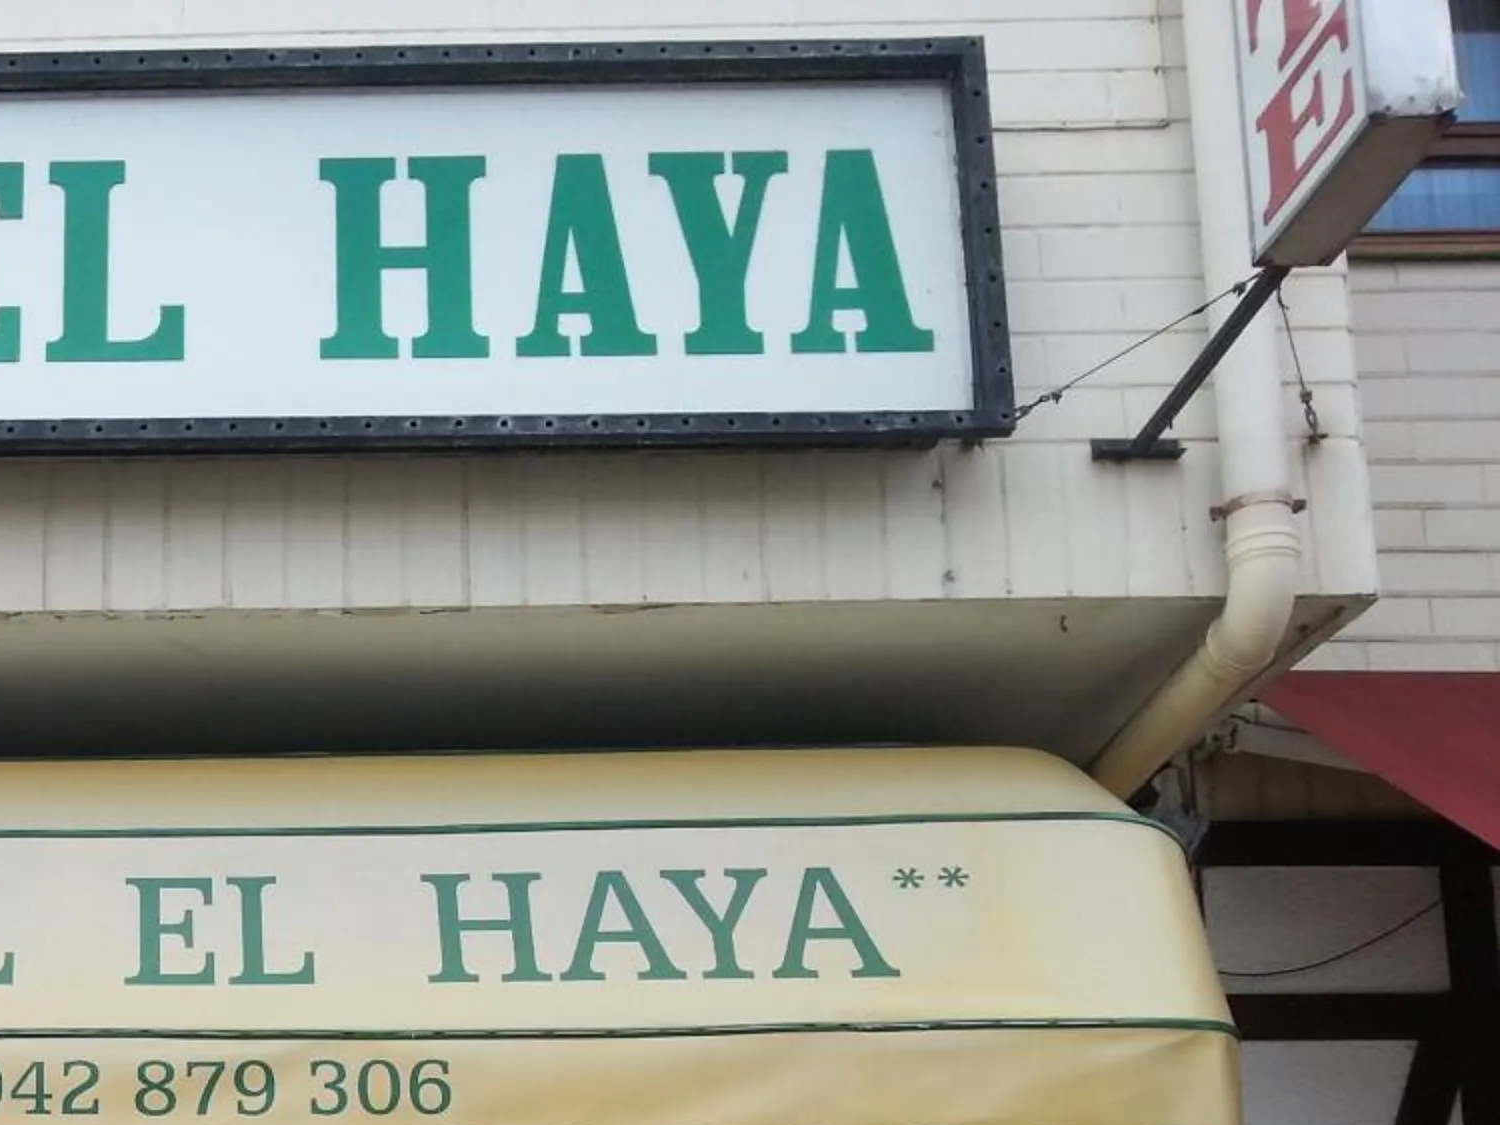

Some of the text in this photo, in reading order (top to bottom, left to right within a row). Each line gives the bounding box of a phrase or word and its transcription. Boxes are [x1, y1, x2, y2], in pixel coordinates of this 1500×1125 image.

[318, 148, 935, 359] HAYA
[123, 876, 316, 986] EL
[132, 1059, 278, 1118] 879
[308, 1059, 454, 1117] 306
